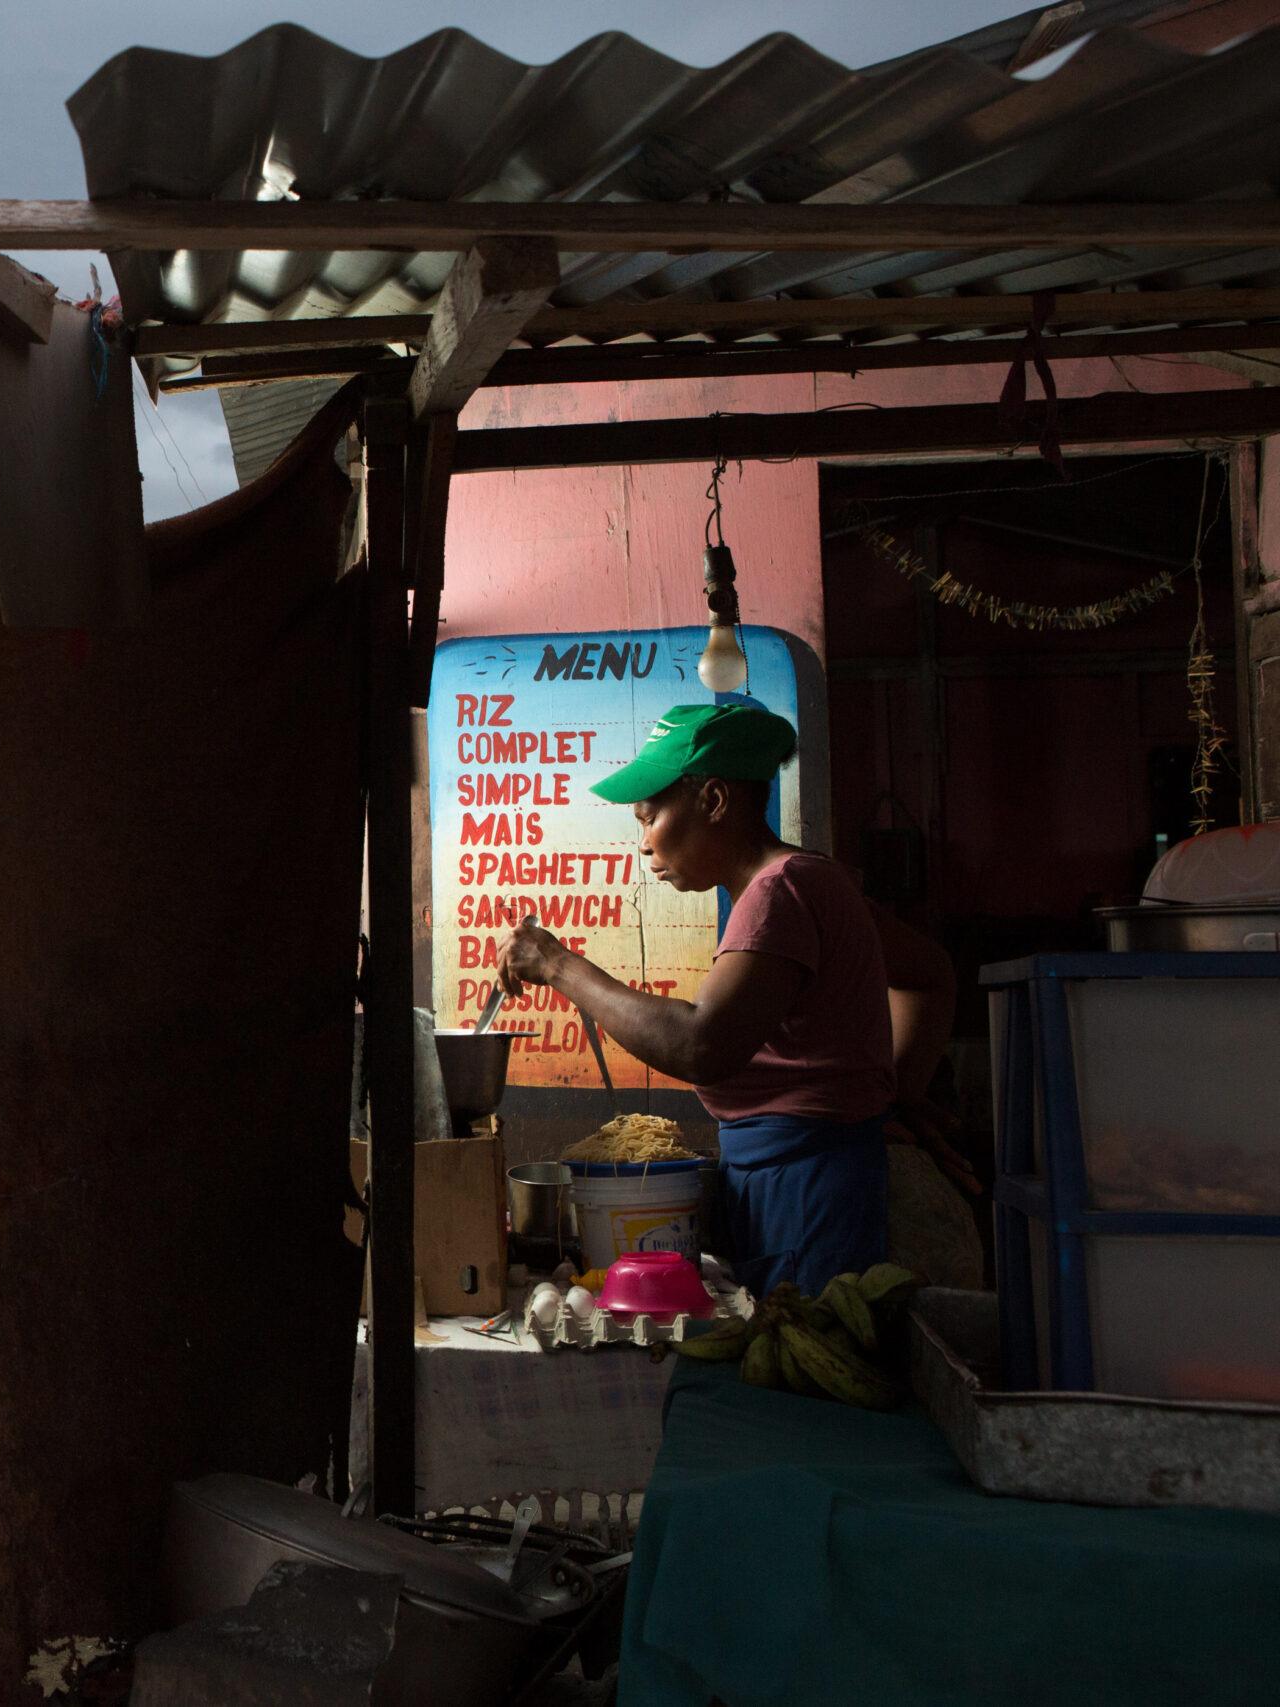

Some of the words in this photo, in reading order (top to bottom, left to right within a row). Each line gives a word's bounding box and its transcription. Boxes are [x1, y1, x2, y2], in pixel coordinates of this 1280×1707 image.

[534, 642, 658, 681] MENU
[456, 694, 515, 727] RIZ
[457, 730, 597, 764] COMPLET
[457, 773, 570, 807] SIMPLE
[458, 852, 634, 886] SPAGHETTI
[457, 895, 623, 928] SANDWICH
